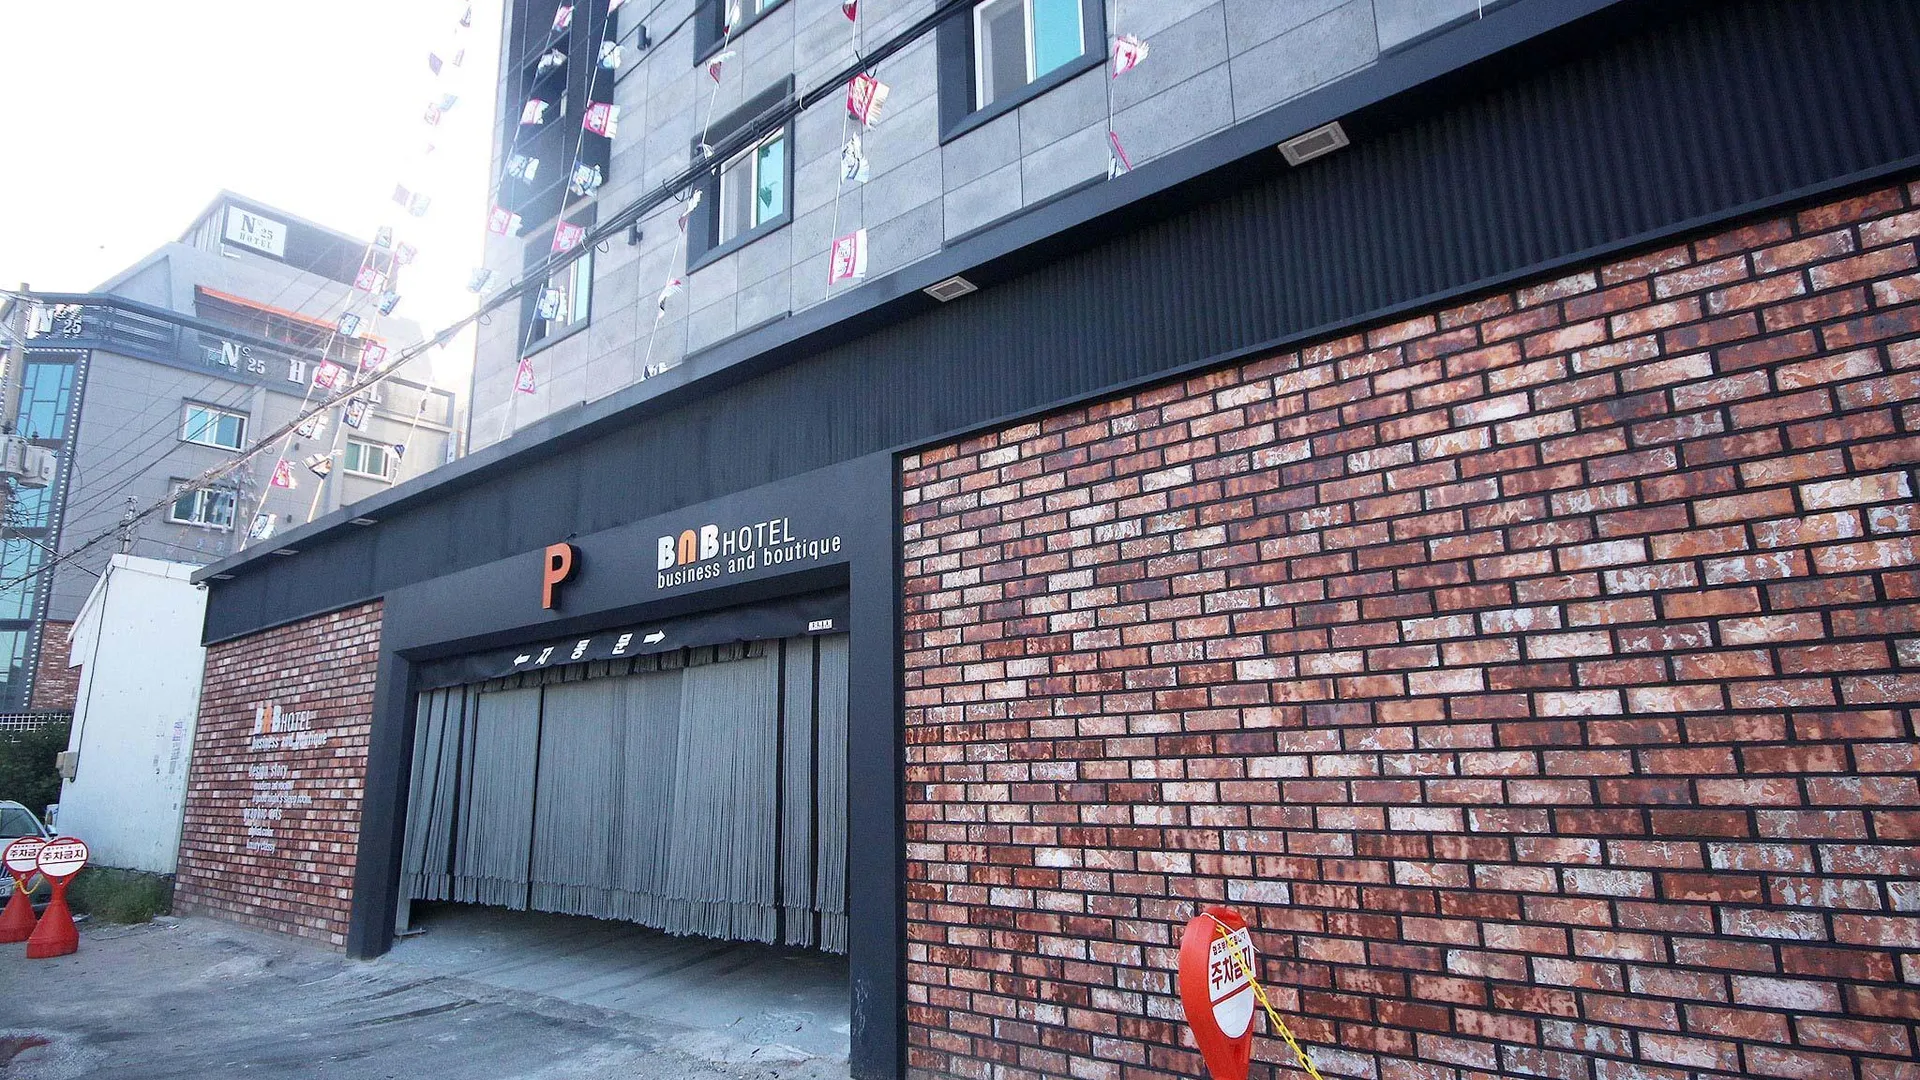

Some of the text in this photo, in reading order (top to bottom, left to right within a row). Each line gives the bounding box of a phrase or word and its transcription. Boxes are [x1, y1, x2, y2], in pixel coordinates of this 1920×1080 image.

[239, 232, 273, 249] HOTEL
[62, 319, 83, 334] 25
[247, 358, 266, 375] 25
[722, 517, 796, 558] HOTEL
[656, 535, 842, 590] business and boutique
[541, 542, 575, 610] P
[281, 710, 311, 733] HOTEL
[10, 848, 42, 858] 주차금
[43, 849, 84, 861] 주차금지
